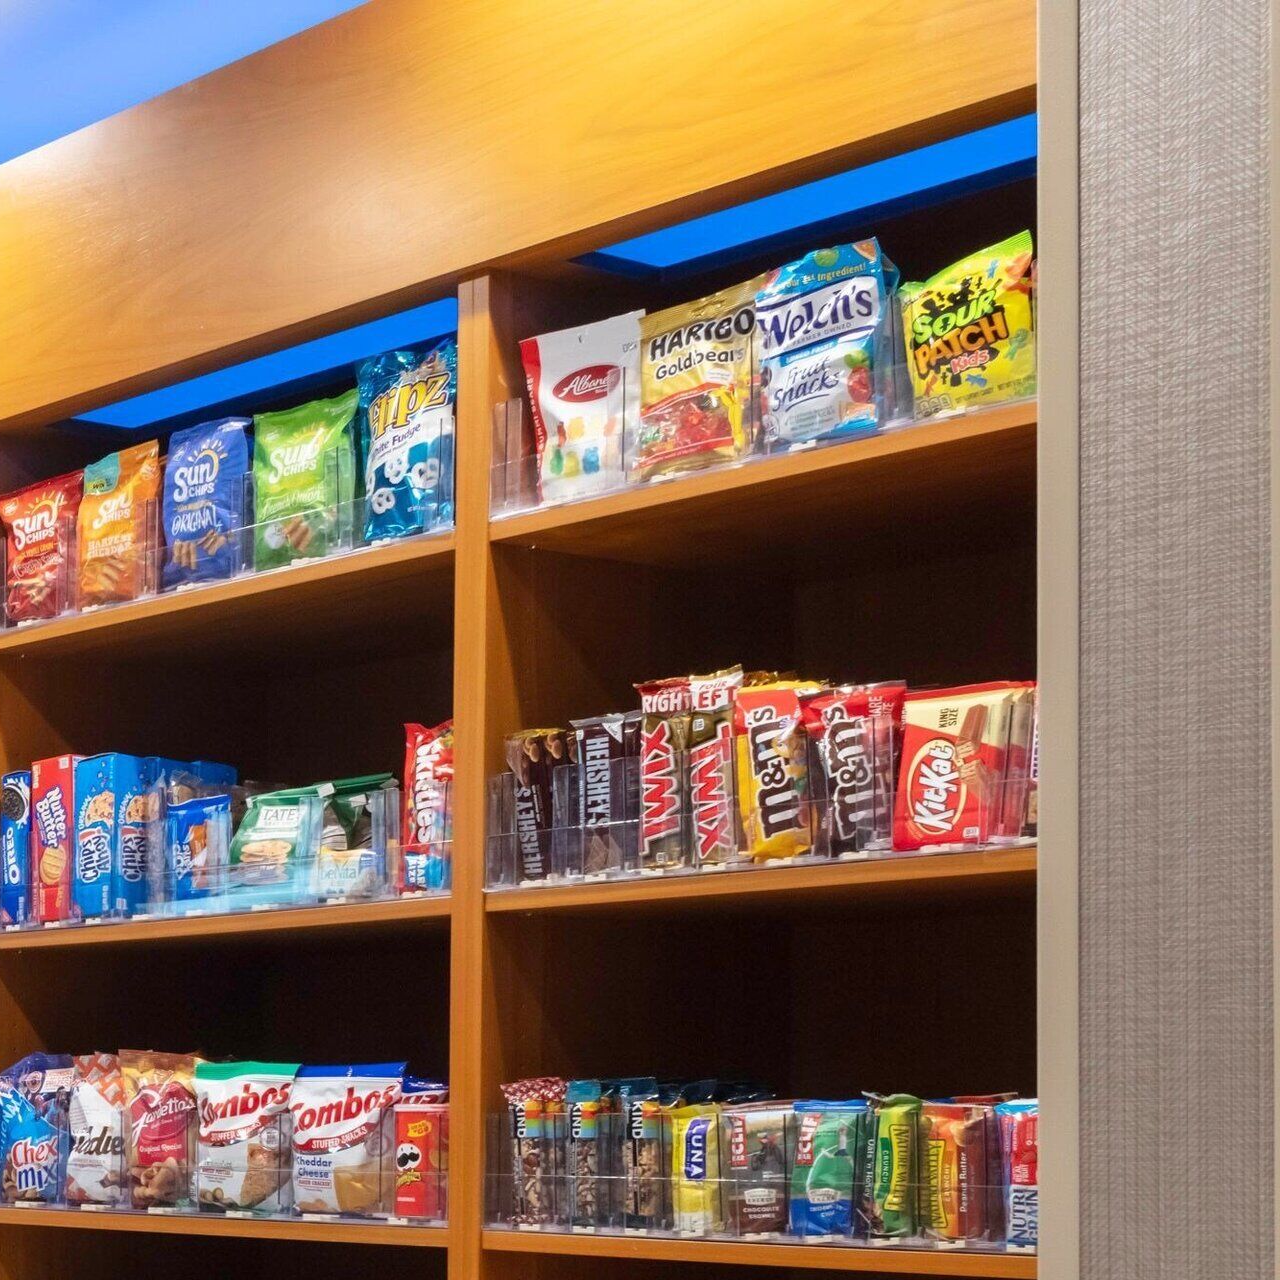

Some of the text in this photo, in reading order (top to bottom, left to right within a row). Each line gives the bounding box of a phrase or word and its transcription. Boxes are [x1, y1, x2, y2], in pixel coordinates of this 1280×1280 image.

[818, 263, 867, 283] Ingredient!
[650, 308, 756, 361] HARIBO
[759, 285, 873, 347] Welch's
[913, 289, 997, 343] SOUR
[914, 313, 1009, 375] PATCH
[950, 349, 990, 374] Kids
[655, 348, 744, 380] Goldbears
[788, 355, 831, 385] Fruit
[772, 370, 840, 412] Snacks
[392, 422, 421, 445] Fudge
[173, 462, 219, 502] Sun
[189, 483, 215, 497] CHIPS
[12, 509, 59, 551] Sun
[26, 527, 55, 544] CHIPS
[172, 504, 222, 535] ORIGINAL
[642, 692, 692, 714] RIGHT
[939, 707, 949, 728] KING
[949, 707, 958, 726] SIZE
[585, 736, 611, 826] HERSHEY'S
[641, 720, 680, 856] TWIX
[691, 722, 734, 859] TWIX
[35, 799, 59, 848] Butter
[46, 787, 67, 840] Nutter
[514, 786, 543, 876] HERSHEY'S
[6, 826, 20, 885] OREO
[80, 839, 99, 882] Chips
[122, 836, 140, 881] Chips
[291, 1082, 401, 1134] Combos
[516, 1101, 526, 1138] KIND
[572, 1102, 582, 1138] KIND
[632, 1101, 643, 1139] KIND
[11, 1138, 58, 1166] Chex
[311, 1125, 367, 1149] STUFFED SNACKS
[690, 1123, 705, 1176] LUNA
[732, 1115, 744, 1154] CLIF
[798, 1117, 818, 1153] CLIF
[295, 1155, 332, 1168] Cheddar
[298, 1169, 329, 1179] Cheese
[959, 1152, 967, 1179] Butter
[1012, 1188, 1027, 1240] NUTRI
